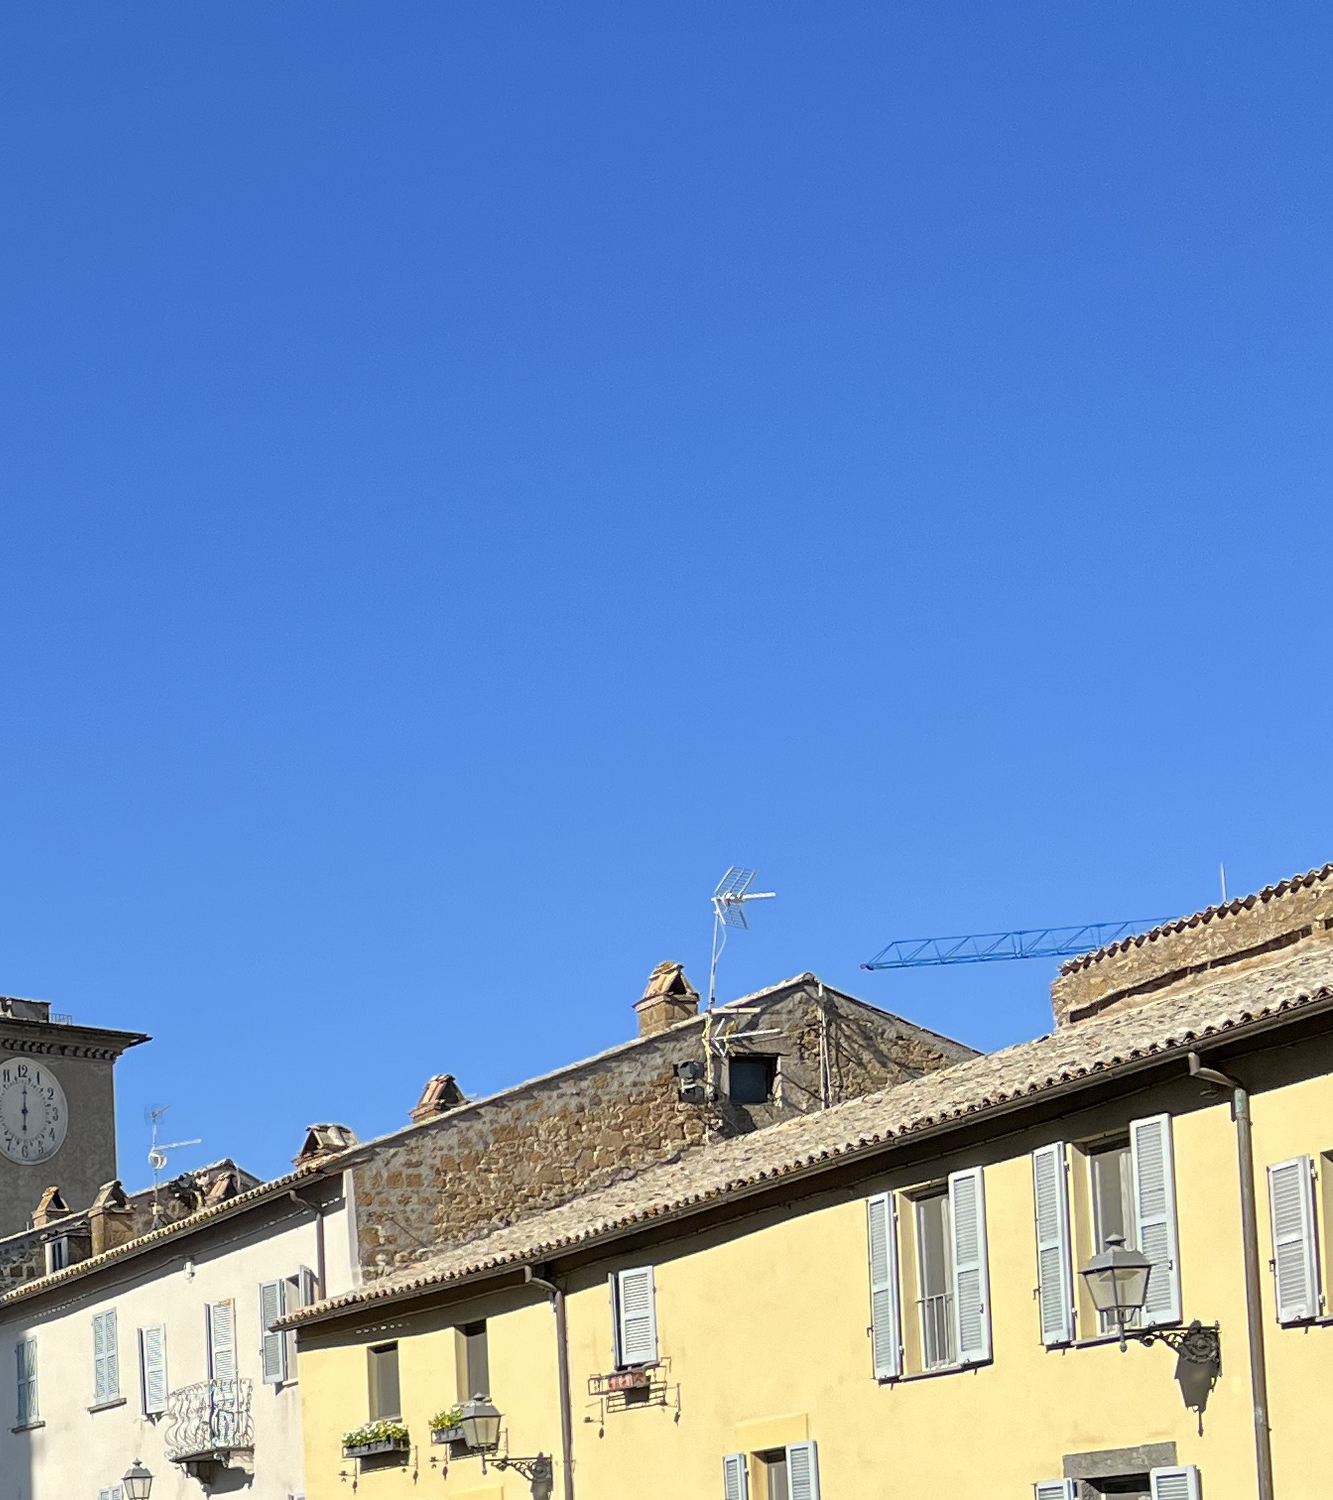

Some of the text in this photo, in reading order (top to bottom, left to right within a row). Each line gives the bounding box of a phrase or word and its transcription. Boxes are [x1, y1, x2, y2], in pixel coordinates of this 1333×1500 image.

[3, 1069, 10, 1082] 11
[18, 1065, 28, 1078] 12
[36, 1071, 41, 1085] 1
[47, 1087, 54, 1100] 2
[52, 1107, 59, 1121] 3
[49, 1128, 55, 1141] 4
[5, 1138, 12, 1151] 7
[22, 1145, 28, 1158] 6
